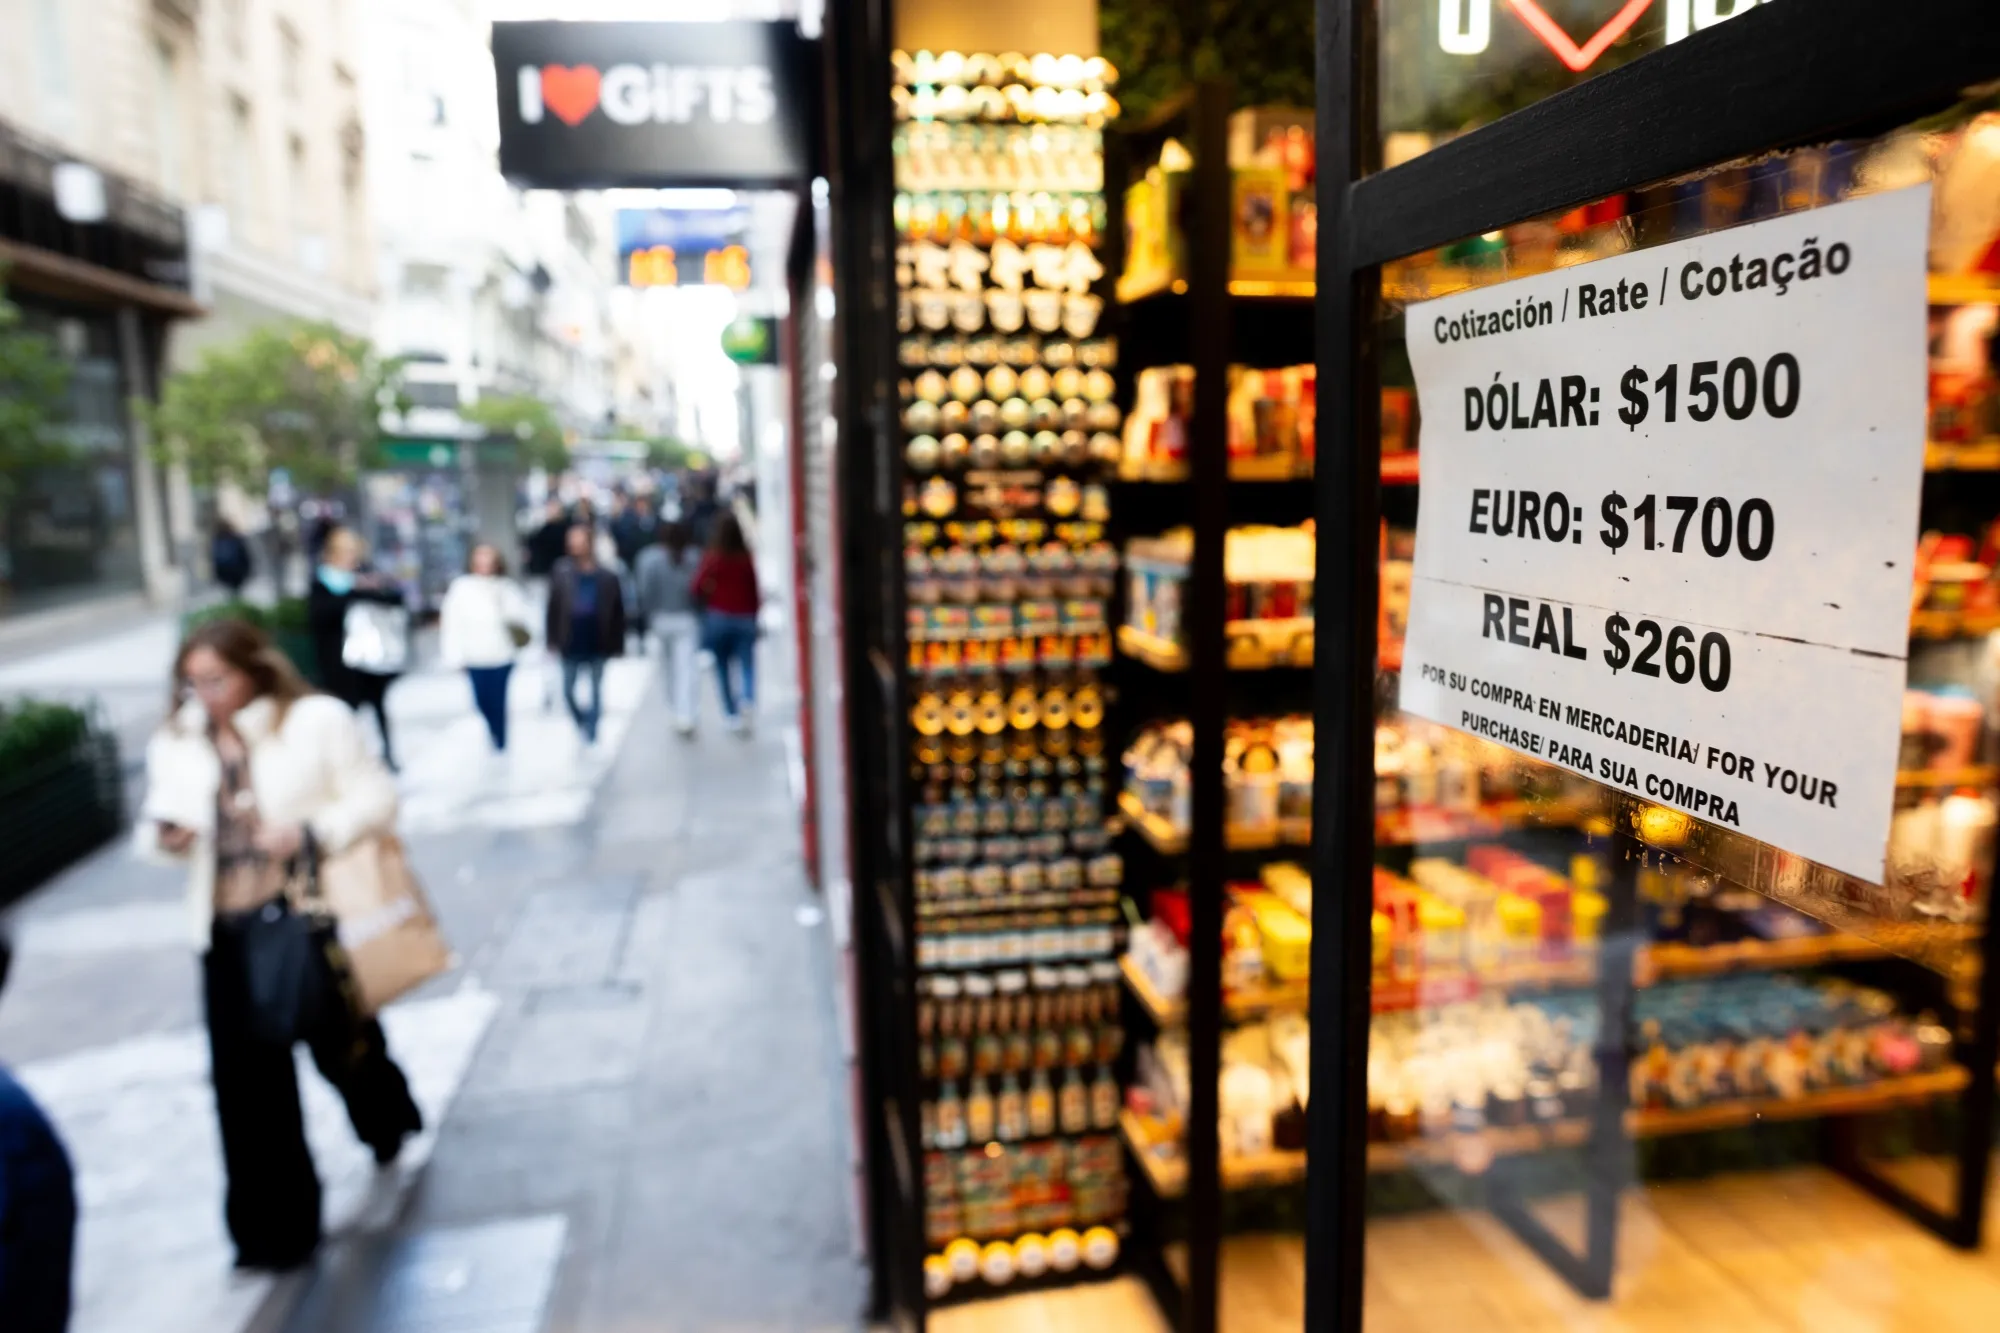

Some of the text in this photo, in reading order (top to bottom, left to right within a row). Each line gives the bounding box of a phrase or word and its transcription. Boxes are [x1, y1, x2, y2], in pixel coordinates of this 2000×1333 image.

[1434, 295, 1553, 344] Cotización
[1578, 277, 1649, 319] Rate
[1680, 237, 1851, 300] Cotação
[1464, 352, 1801, 433] DÓLAR: $1500
[1469, 488, 1582, 545] EURO:
[1482, 593, 1732, 693] REAL $260
[1421, 663, 1446, 687] POR
[1449, 672, 1467, 692] SU
[1471, 678, 1534, 713] COMPRA
[1538, 697, 1562, 722] EN
[1706, 746, 1755, 783] FOR
[1763, 762, 1838, 809] YOUR
[1461, 710, 1740, 827] PURCHASE/ PARA SUA COMPRA
